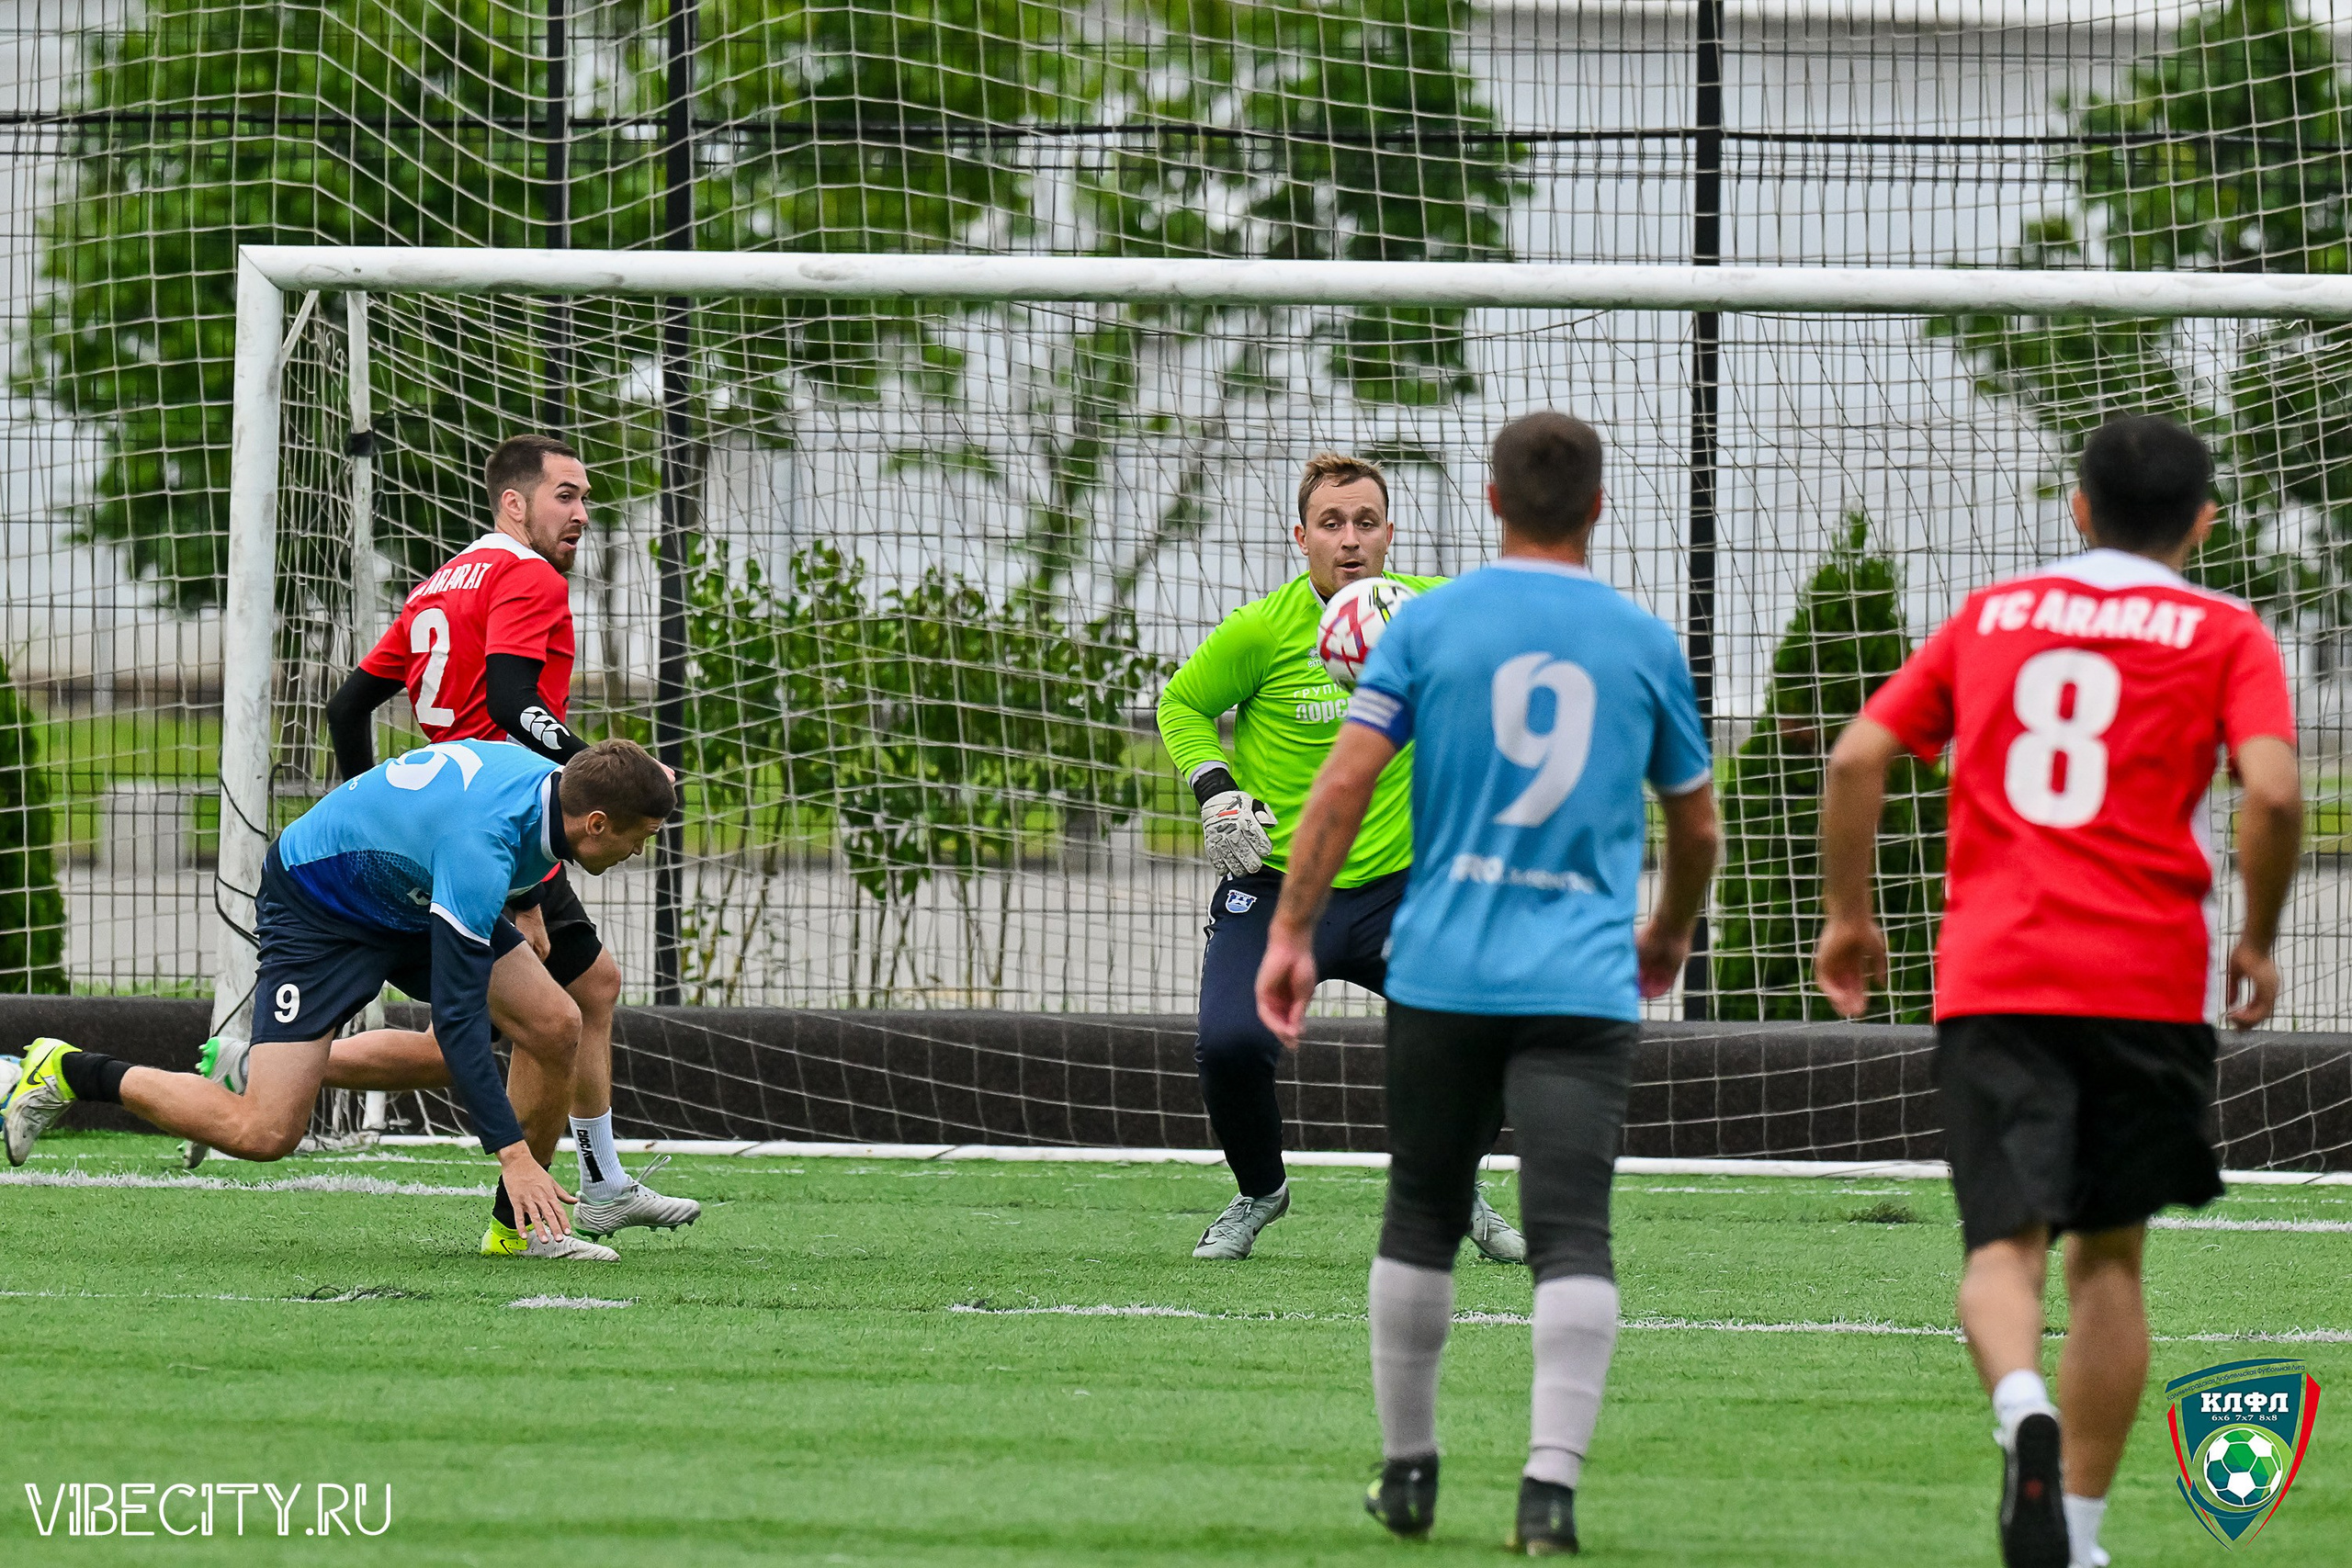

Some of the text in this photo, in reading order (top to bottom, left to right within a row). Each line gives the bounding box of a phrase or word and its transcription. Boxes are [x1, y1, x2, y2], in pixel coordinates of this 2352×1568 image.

[1978, 589, 2207, 649] FC ARARAT
[410, 608, 455, 728] 2
[1293, 683, 1343, 699] ГРУПП
[1491, 650, 1597, 828] 9
[2004, 649, 2121, 829] 8
[274, 984, 300, 1024] 9
